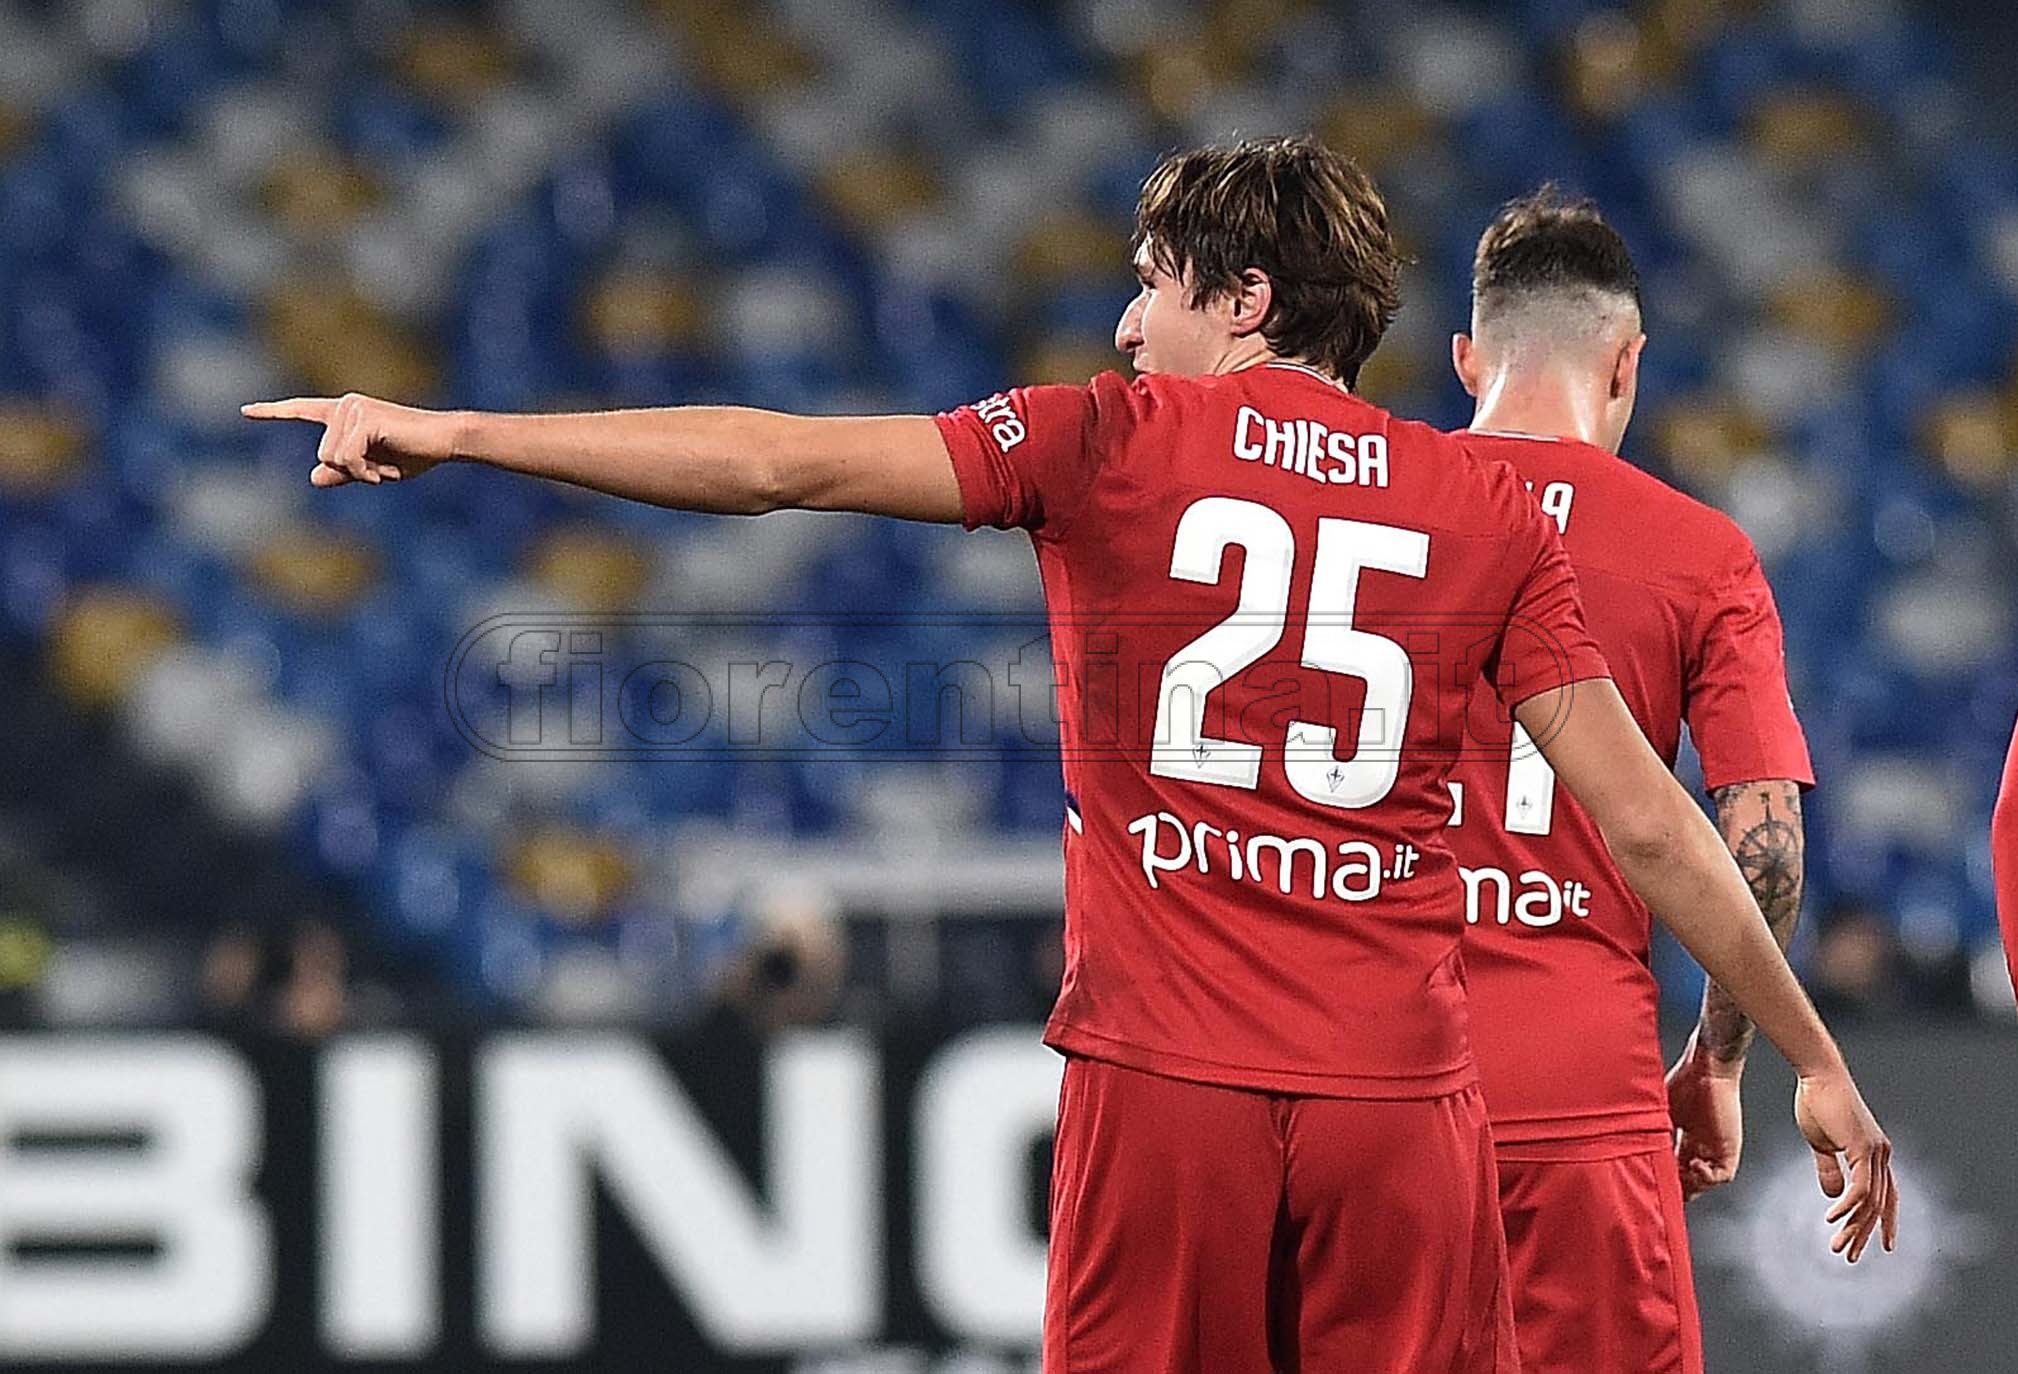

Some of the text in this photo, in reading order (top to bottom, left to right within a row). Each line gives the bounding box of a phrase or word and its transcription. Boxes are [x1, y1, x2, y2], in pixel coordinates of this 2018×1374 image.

[1234, 406, 1389, 487] CHIESA
[1151, 497, 1430, 809] 25
[1128, 812, 1420, 901] prima.it
